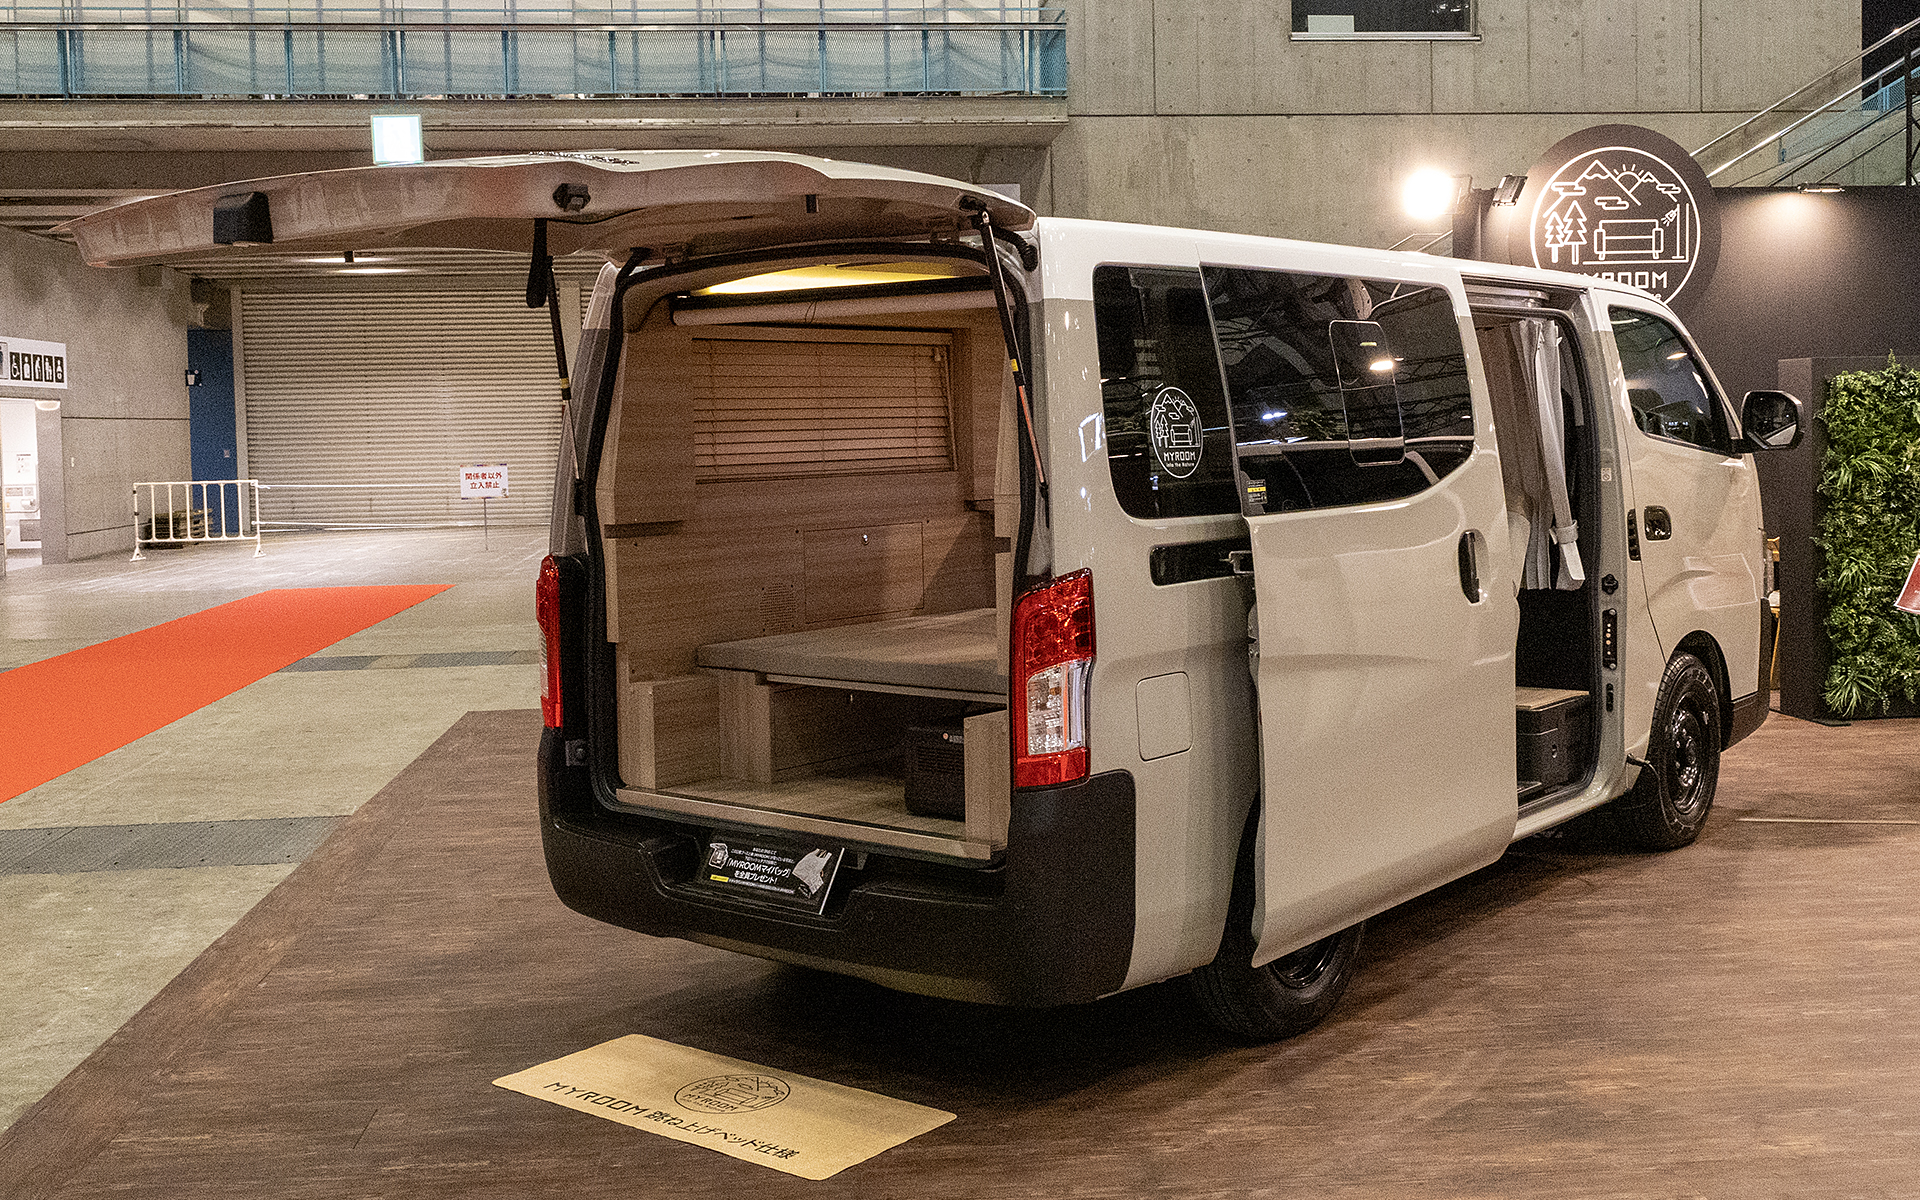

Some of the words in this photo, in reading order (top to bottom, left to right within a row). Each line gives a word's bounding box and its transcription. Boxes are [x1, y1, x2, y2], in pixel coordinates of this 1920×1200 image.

[1580, 271, 1668, 289] ROOM
[1163, 451, 1196, 462] MYROOM
[465, 472, 502, 480] 関係者以外
[470, 481, 500, 489] 立入禁止
[682, 1094, 739, 1112] MYROOM
[543, 1082, 650, 1116] MYROOM
[643, 1110, 800, 1160] 跳ね上げベッド仕様
